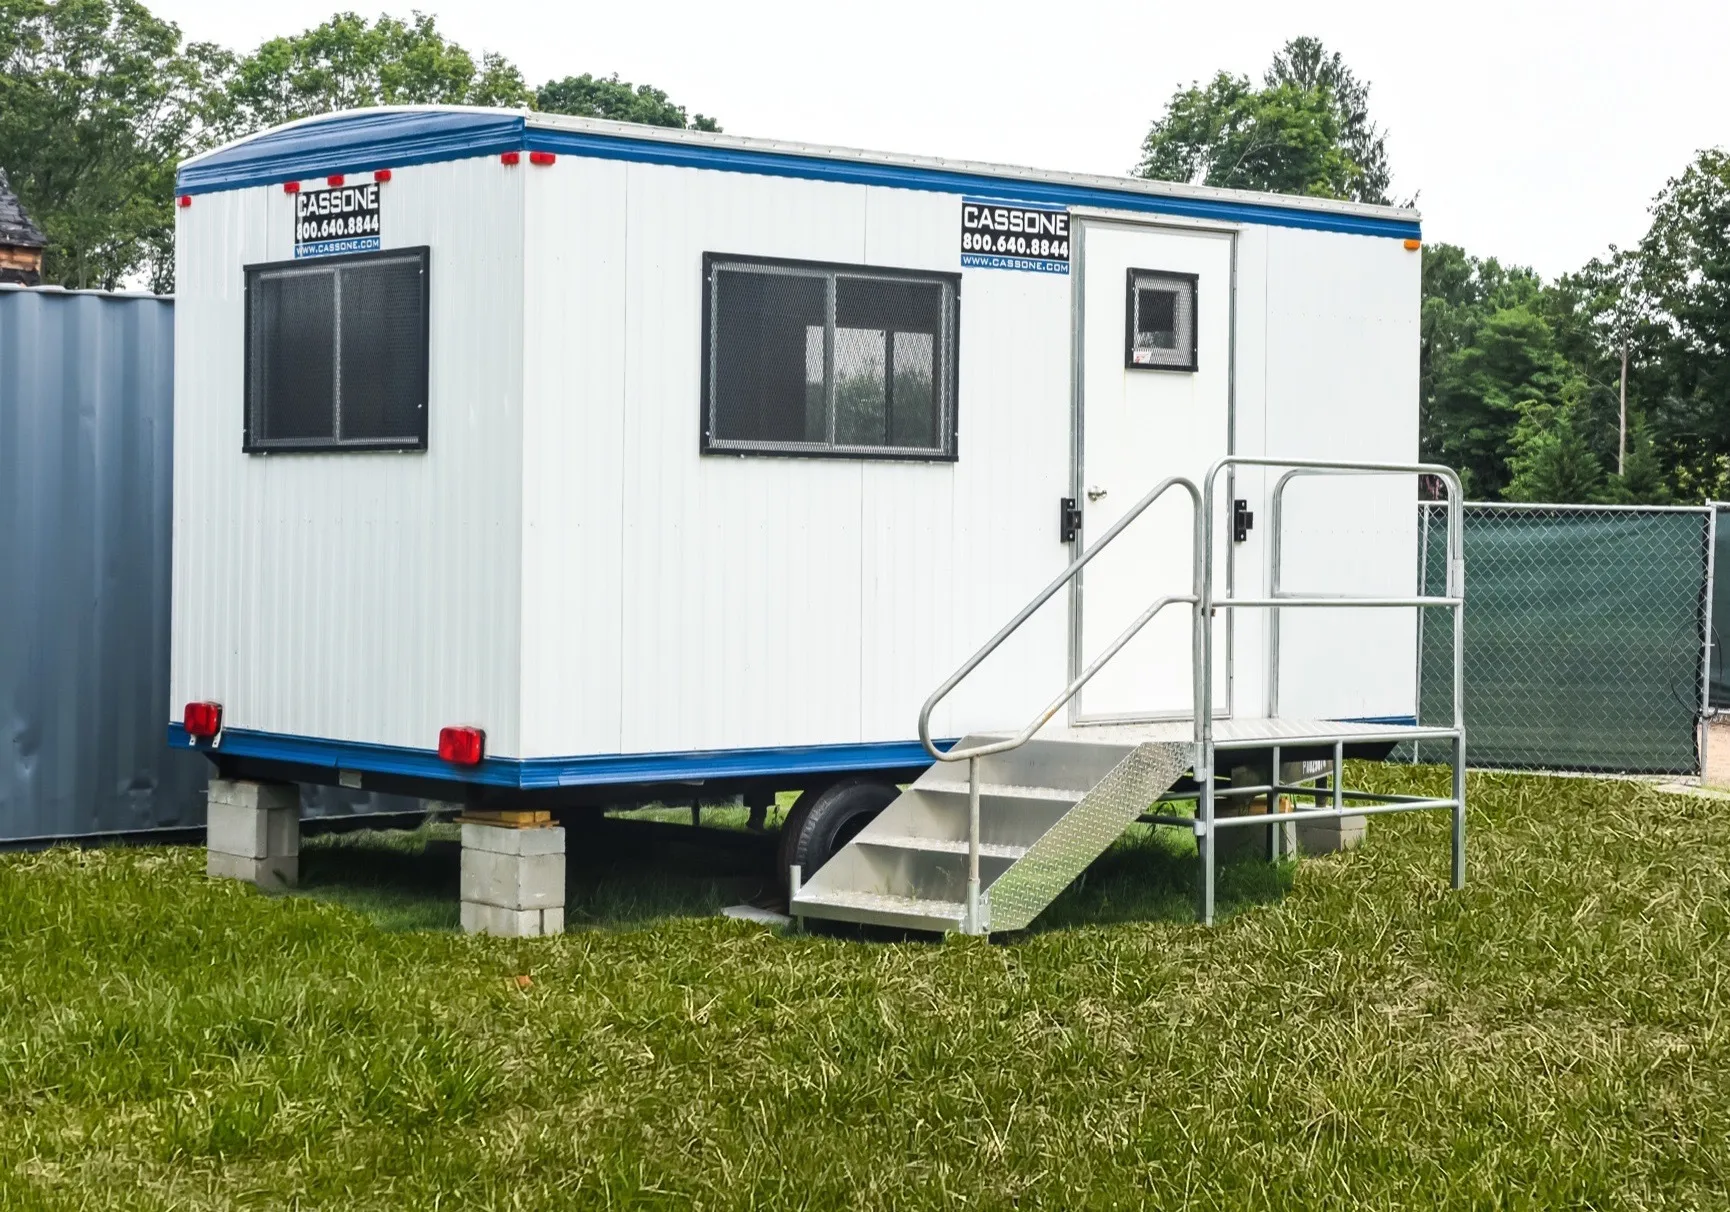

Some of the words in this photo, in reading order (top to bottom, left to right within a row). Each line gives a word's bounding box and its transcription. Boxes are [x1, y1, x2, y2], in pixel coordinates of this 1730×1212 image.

[297, 186, 378, 217] CASSONE
[296, 214, 379, 240] 800.640.8844
[964, 206, 1068, 236] CASSONE
[296, 239, 379, 255] WWW.CASSONE.COM
[963, 232, 1068, 258] 800.640.8844
[963, 256, 1068, 272] WWW.CASSONE.COM
